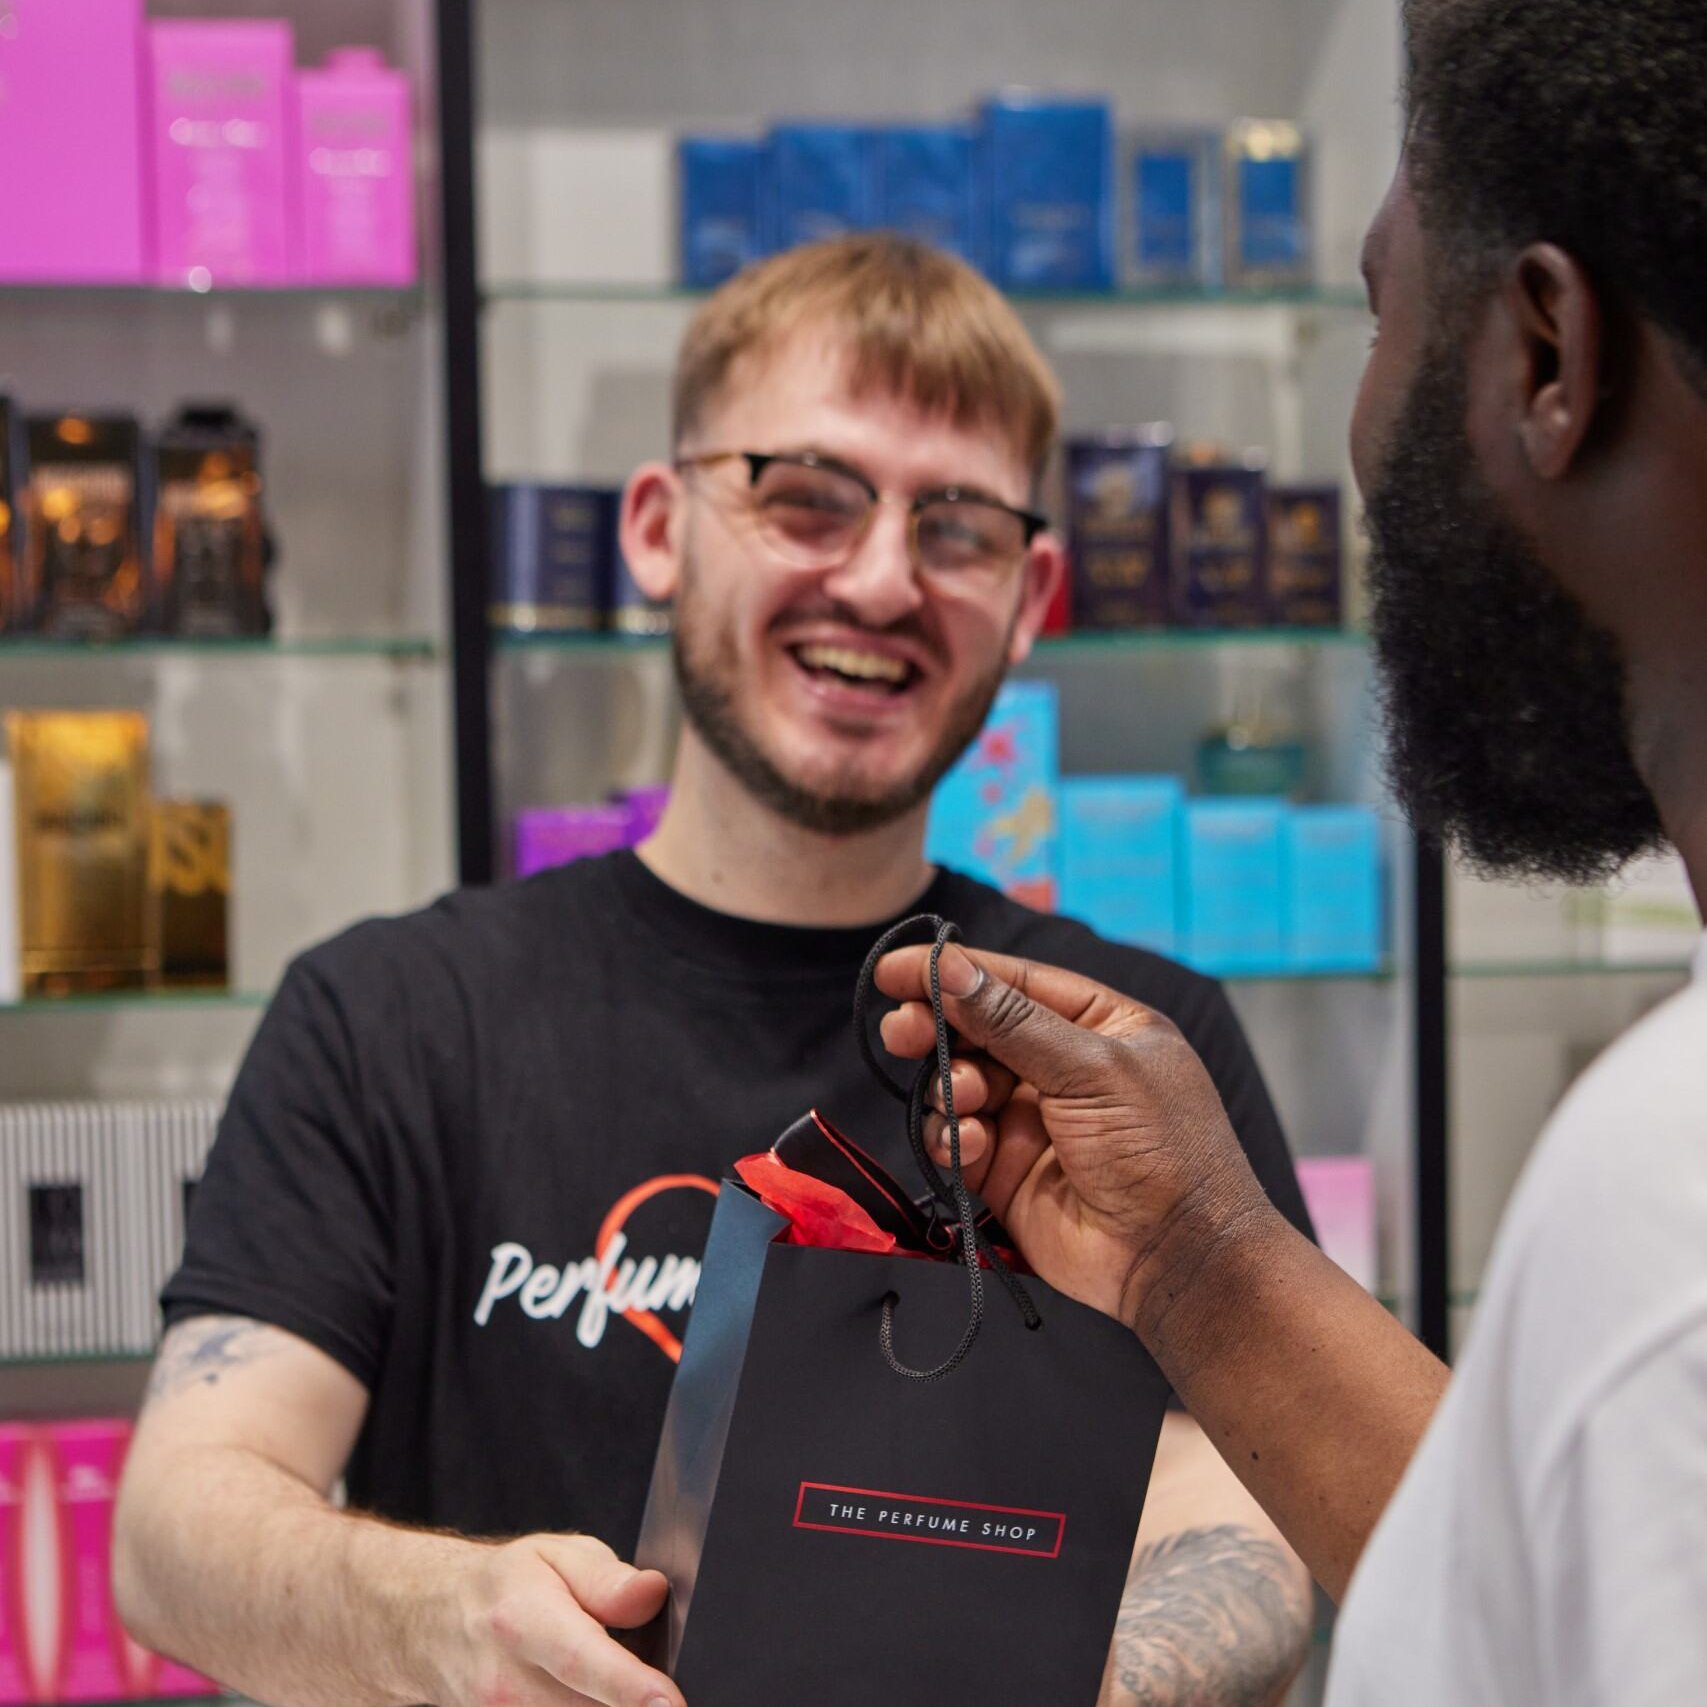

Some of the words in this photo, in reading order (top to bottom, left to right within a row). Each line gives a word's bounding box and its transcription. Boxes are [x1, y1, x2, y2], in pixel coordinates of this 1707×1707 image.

[829, 1503, 867, 1520] THE
[878, 1509, 971, 1533] PERFUME
[981, 1522, 1037, 1541] SHOP
